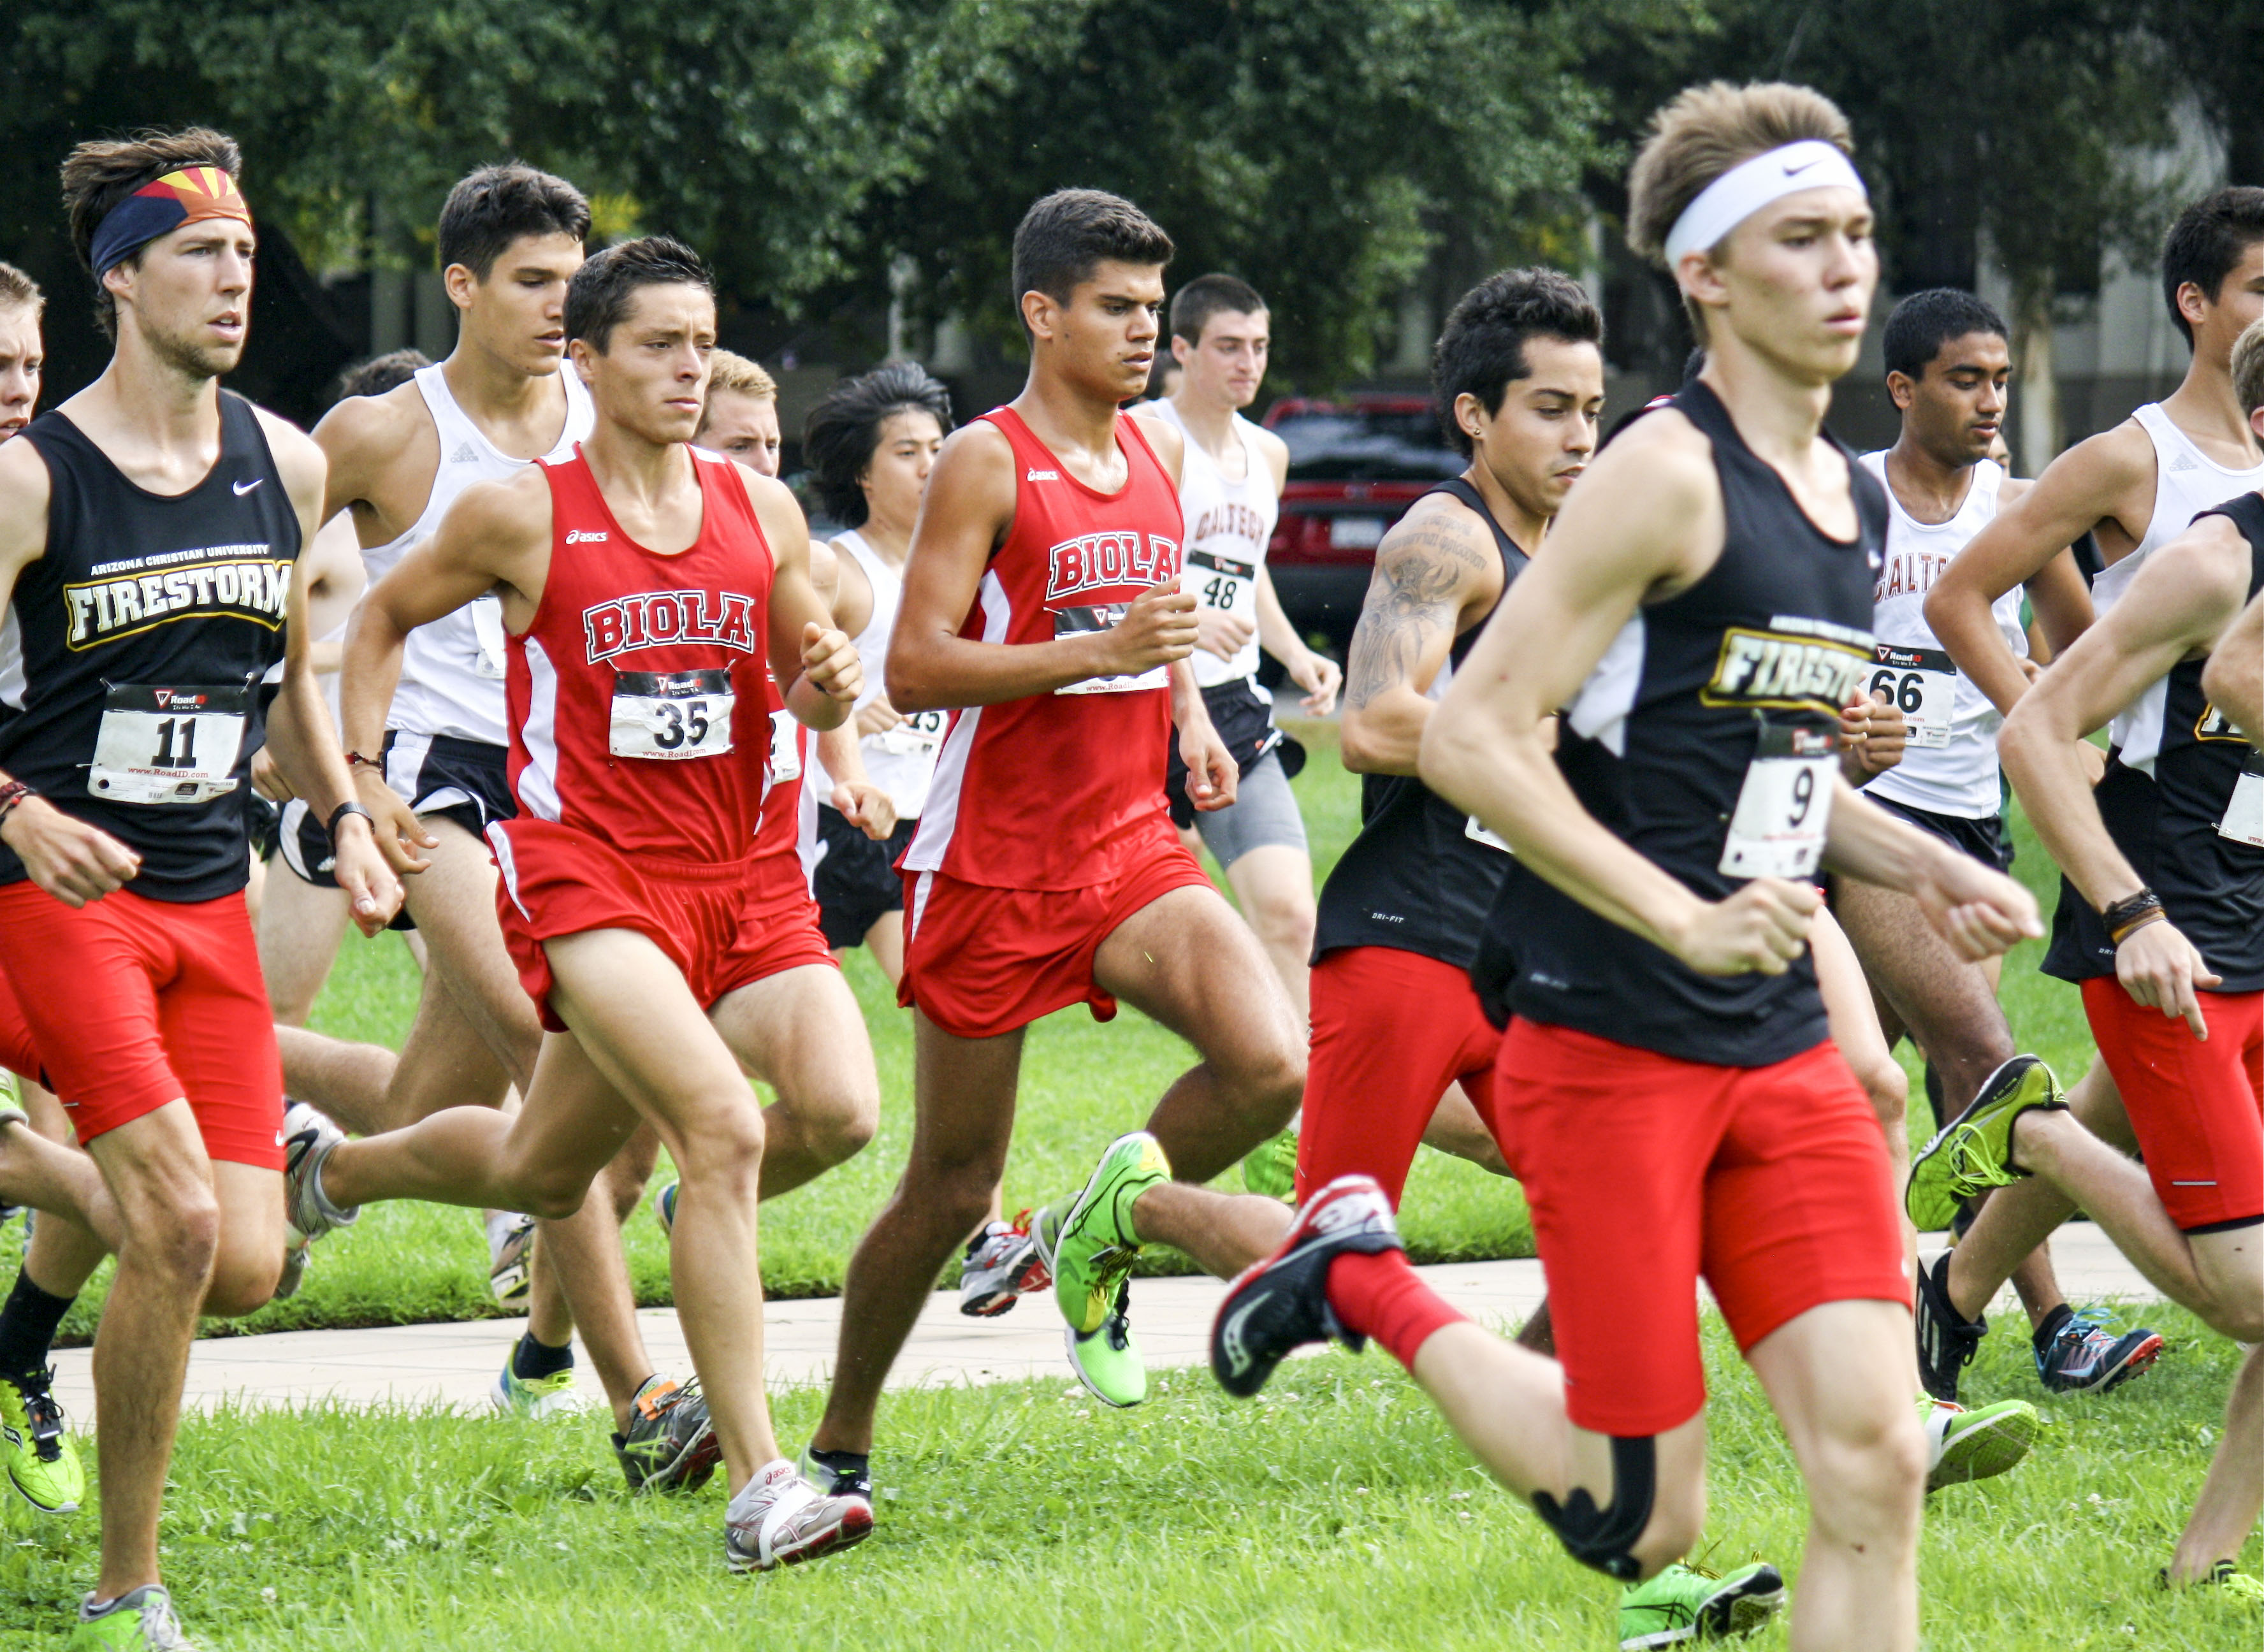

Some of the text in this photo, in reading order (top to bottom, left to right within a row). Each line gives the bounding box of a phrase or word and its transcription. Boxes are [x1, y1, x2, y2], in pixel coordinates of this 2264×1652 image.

[91, 544, 270, 576] ARIZONA CHRISTIAN UNIVERSITY
[1045, 531, 1177, 602] BIOLA
[68, 564, 292, 642] FIRESTORM
[1204, 577, 1237, 609] 48
[582, 590, 755, 665] BIOLA
[1869, 670, 1924, 713] 66
[150, 718, 197, 769] 11
[653, 701, 709, 750] 35
[127, 767, 209, 778] www.RoadID.com
[1787, 766, 1814, 828] 9
[1372, 912, 1404, 923] DRI-FIT
